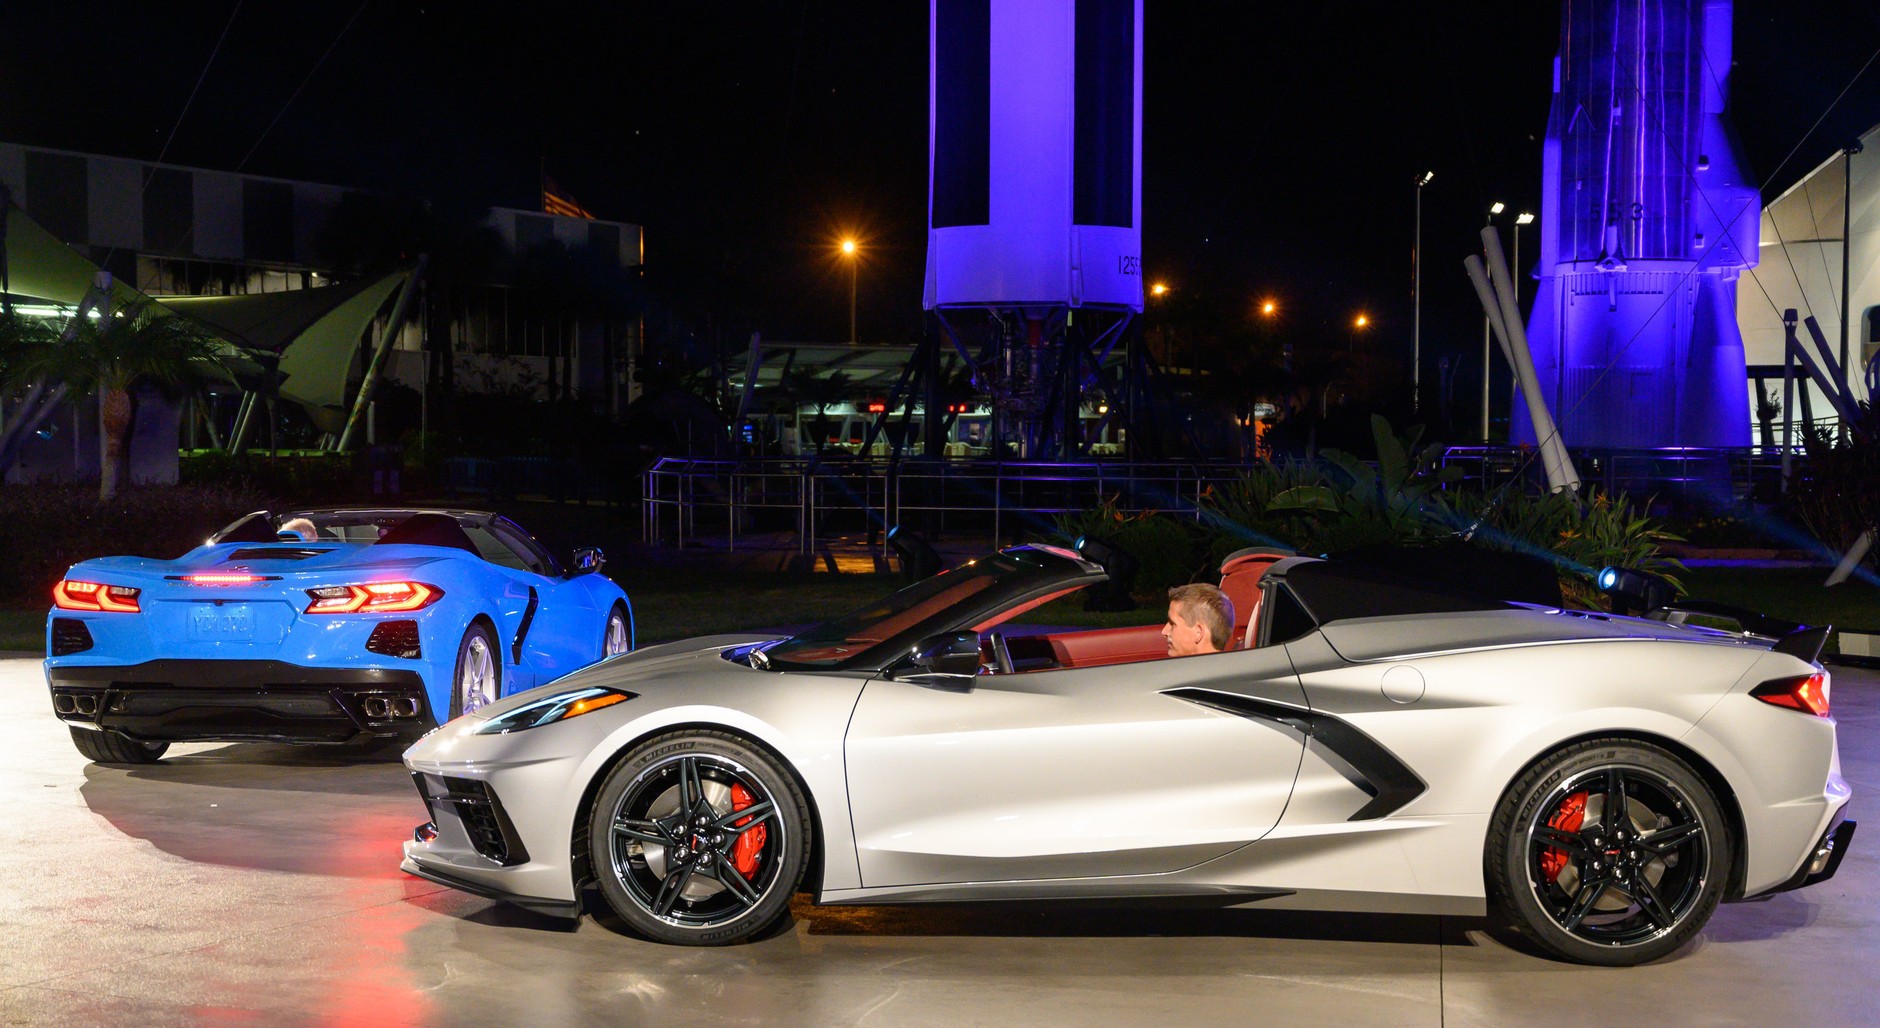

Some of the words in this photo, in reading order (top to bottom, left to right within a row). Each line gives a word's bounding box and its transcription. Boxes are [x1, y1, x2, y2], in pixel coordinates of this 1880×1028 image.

[645, 741, 693, 761] MICHELIN
[1522, 773, 1560, 818] MICHELIN
[701, 921, 750, 940] MICHELIN
